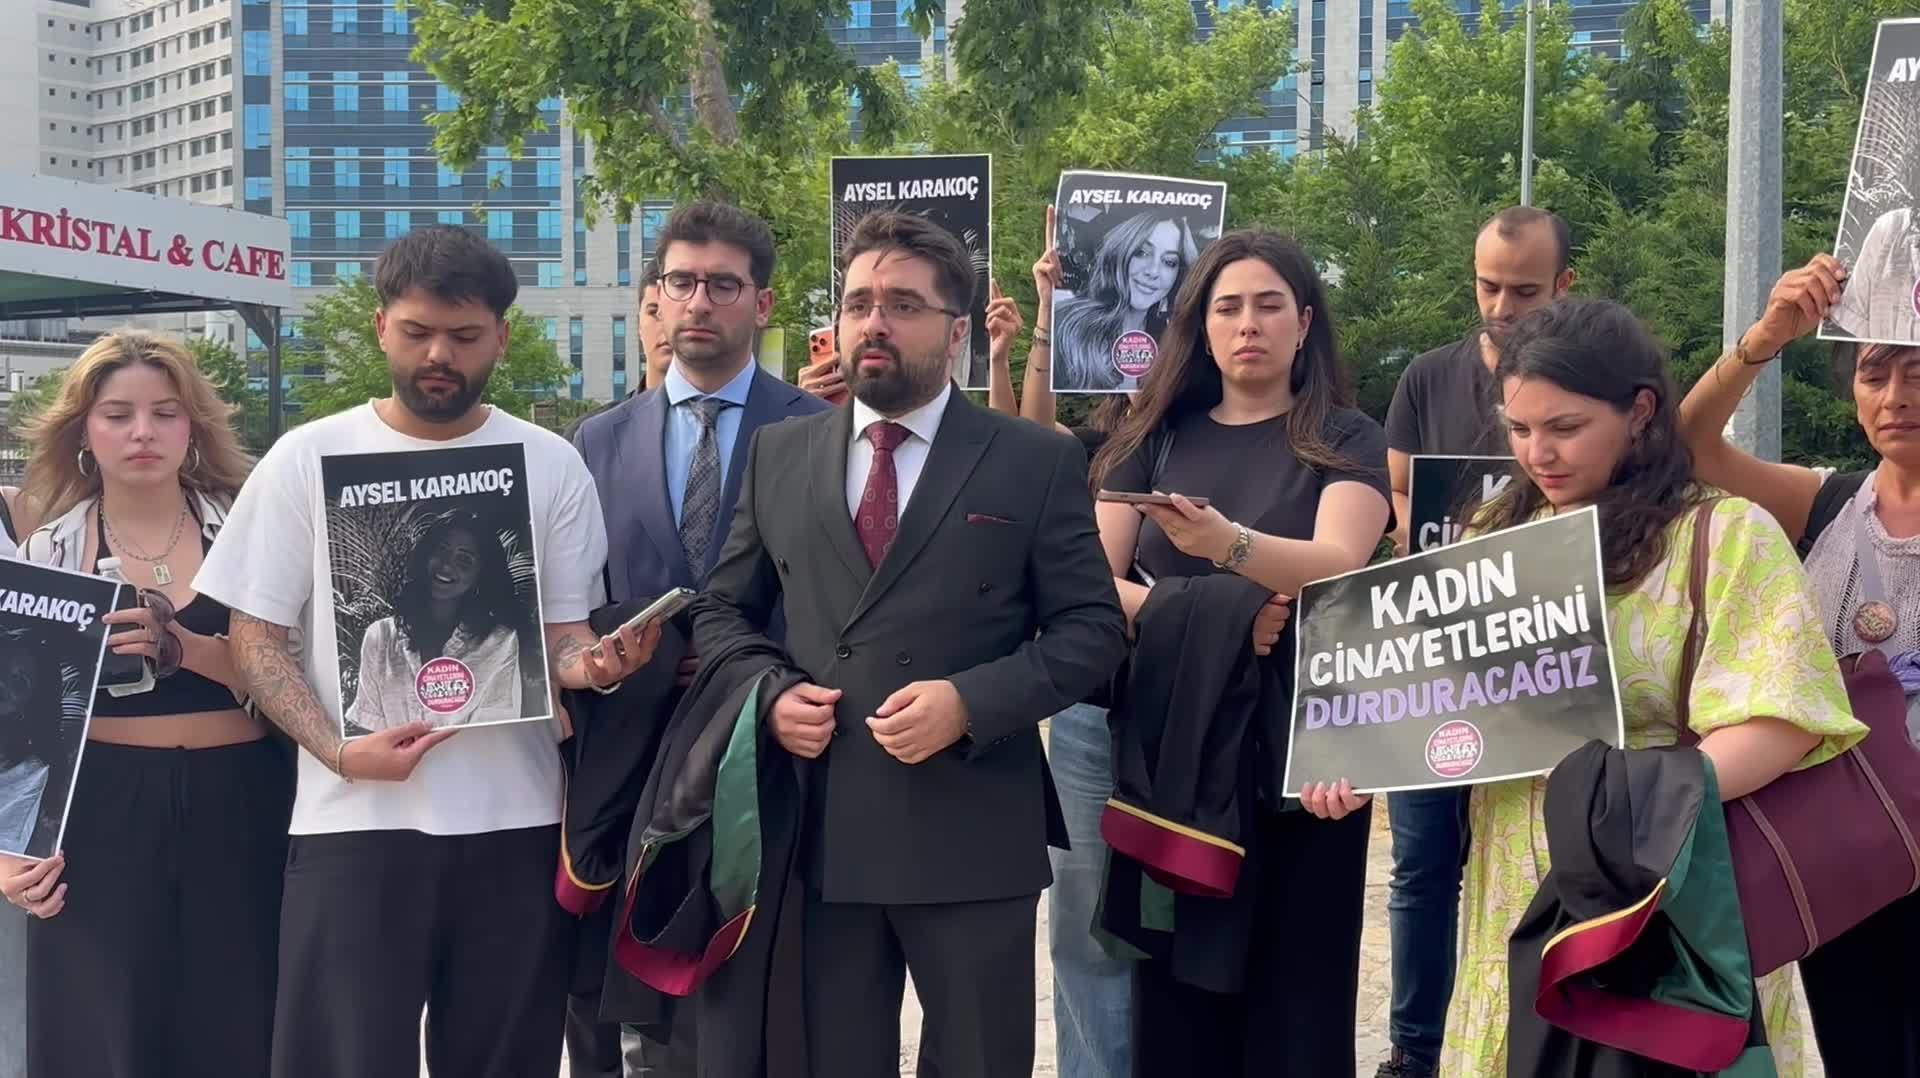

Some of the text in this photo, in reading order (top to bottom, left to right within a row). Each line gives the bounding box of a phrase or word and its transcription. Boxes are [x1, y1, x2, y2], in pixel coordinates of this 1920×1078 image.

[844, 176, 979, 202] AYSEL KARAKOÇ
[1069, 189, 1212, 210] AYSEL KARAKOÇ
[0, 205, 286, 280] KRİSTAL & CAFE
[340, 467, 514, 508] AYSEL KARAKOÇ
[1370, 551, 1517, 629] KADIN
[1309, 584, 1591, 687] CİNAYETLERİNİ
[1305, 645, 1598, 730] DURDURACAĞIZ
